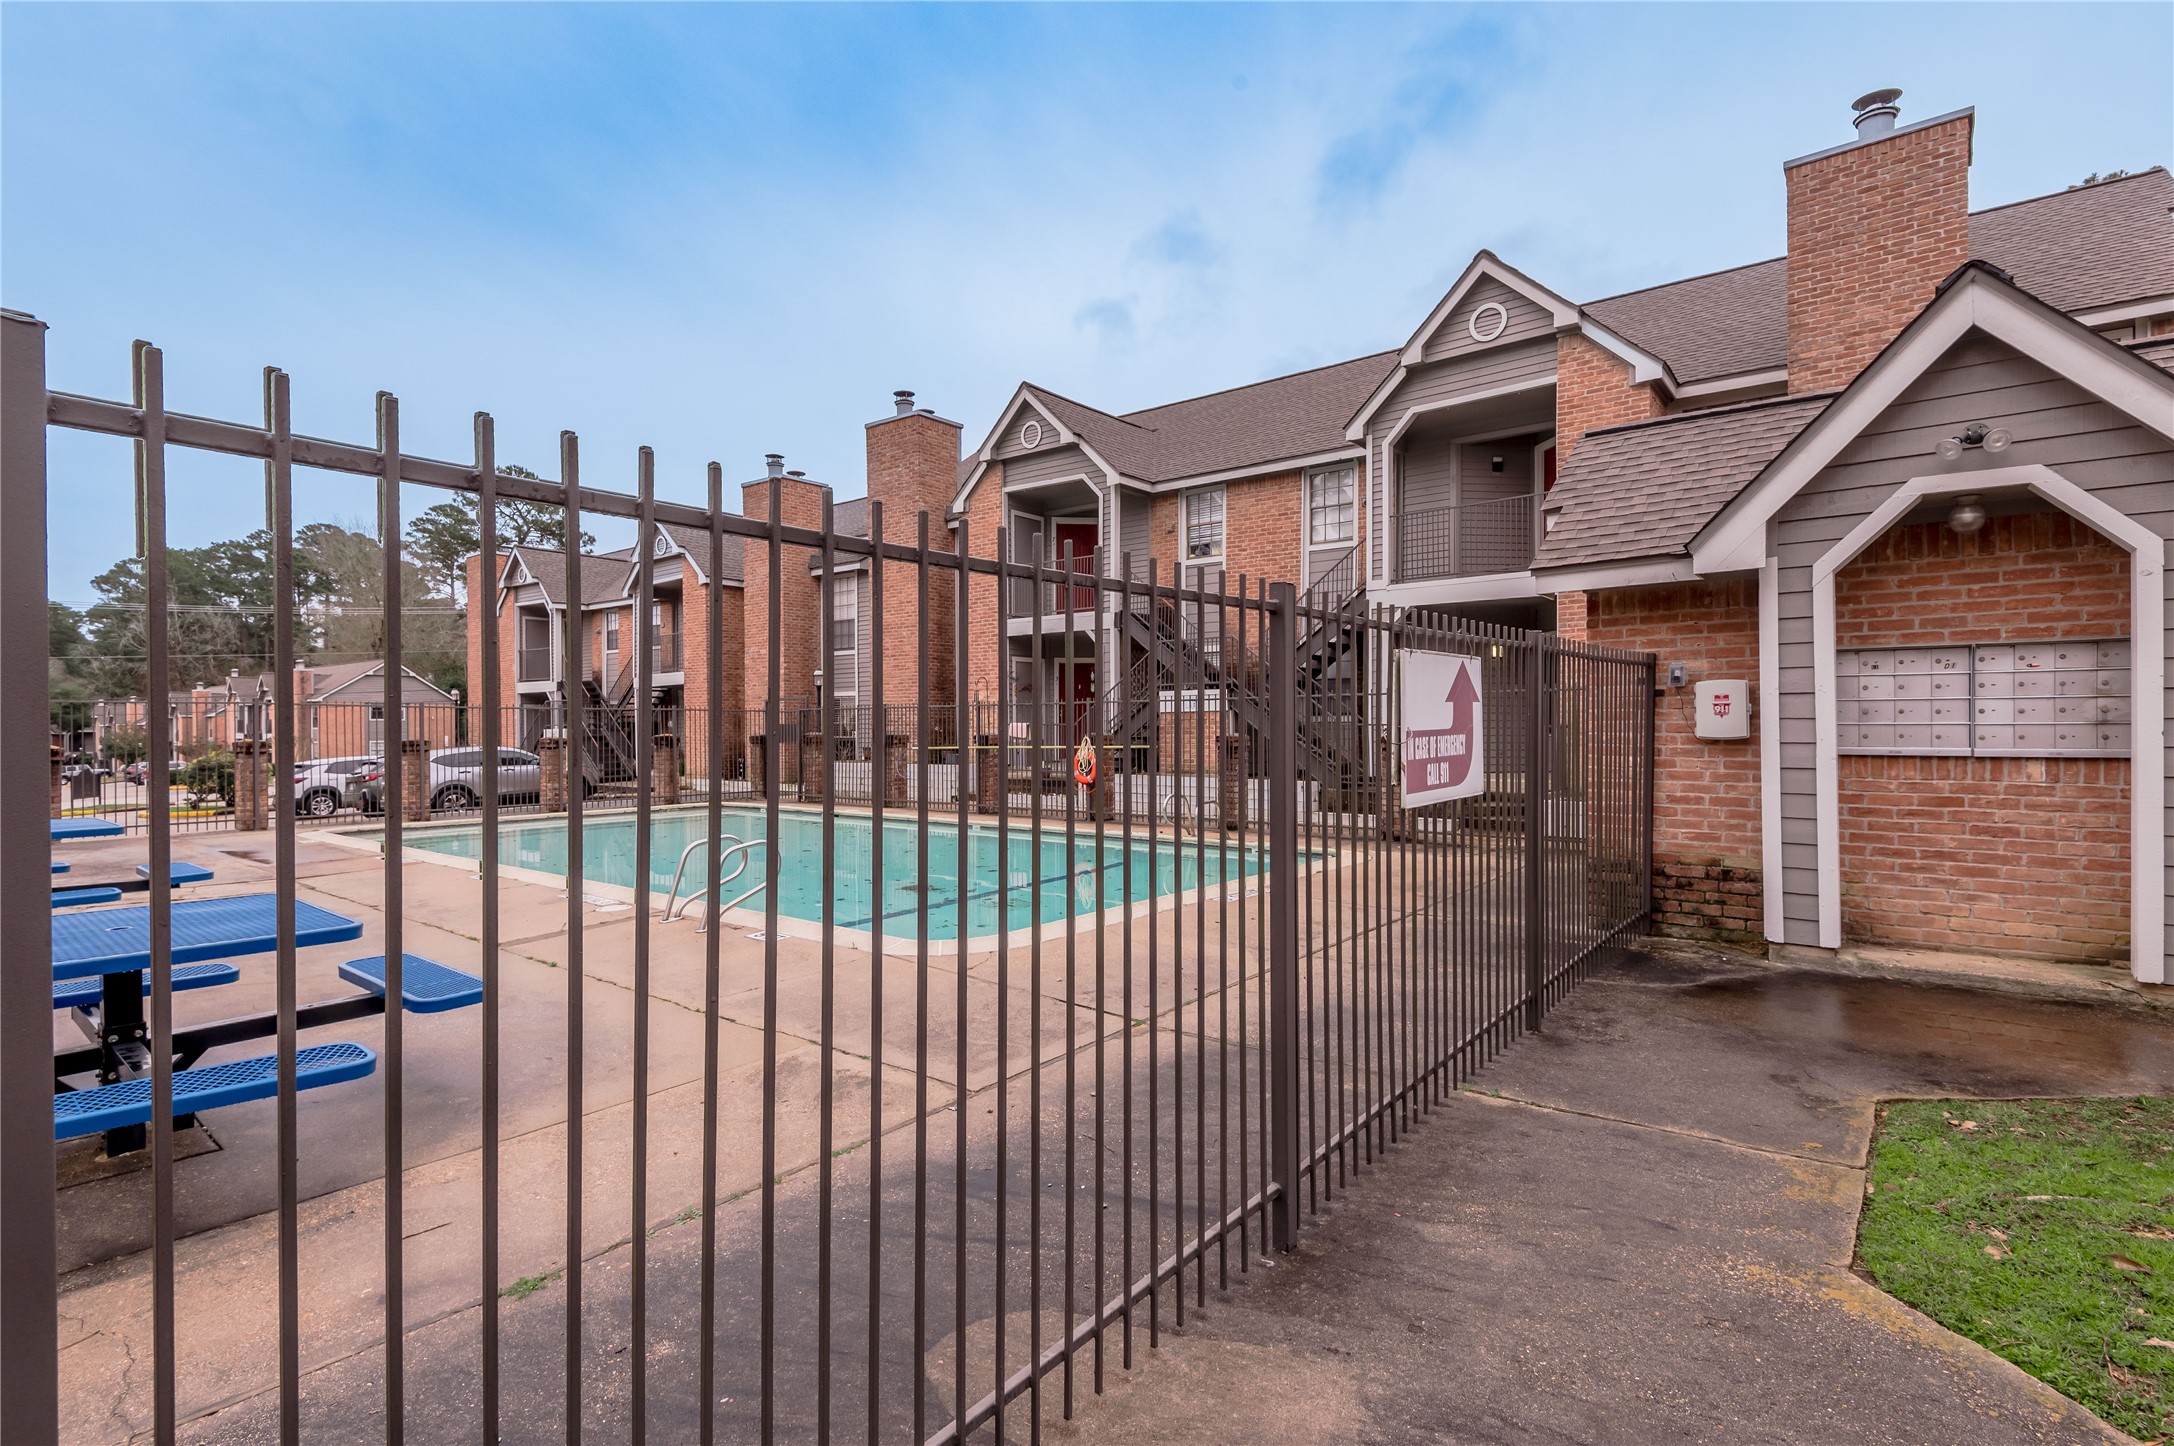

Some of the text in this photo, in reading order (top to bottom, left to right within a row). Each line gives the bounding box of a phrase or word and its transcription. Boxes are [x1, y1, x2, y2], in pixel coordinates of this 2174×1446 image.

[1407, 734, 1466, 761] IN CASE OF EMERGENCY
[1427, 761, 1449, 786] CALL 911
